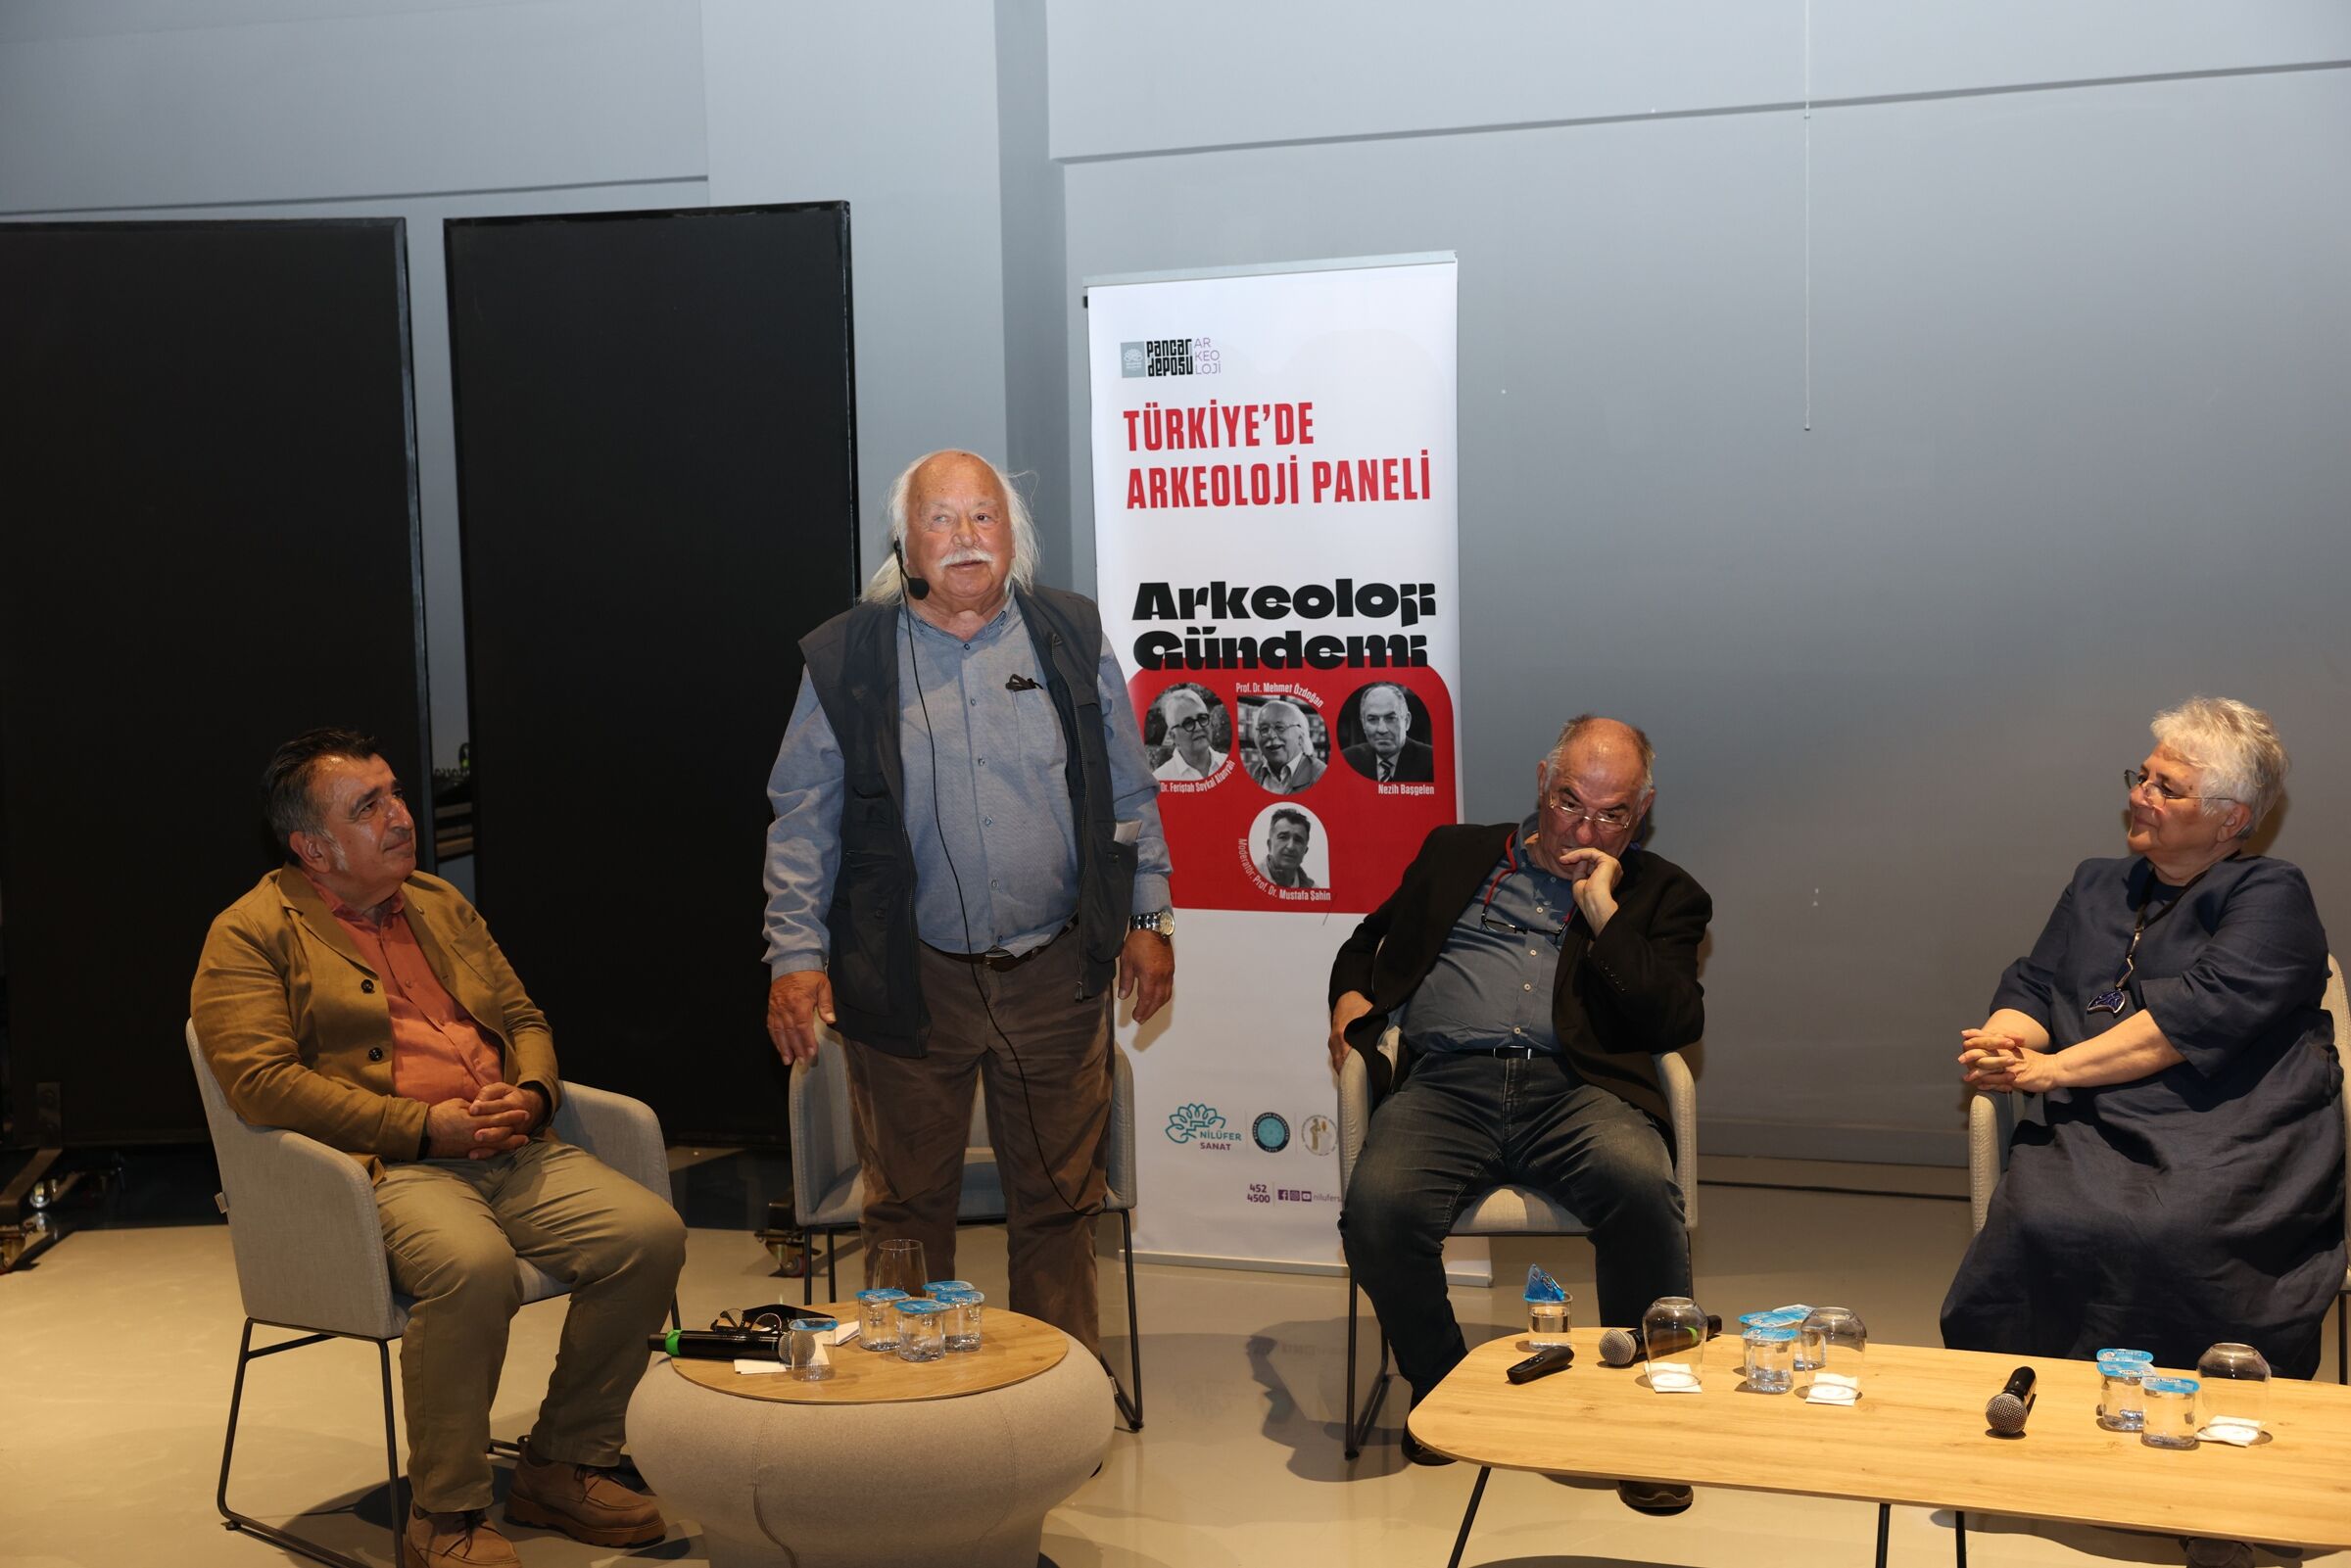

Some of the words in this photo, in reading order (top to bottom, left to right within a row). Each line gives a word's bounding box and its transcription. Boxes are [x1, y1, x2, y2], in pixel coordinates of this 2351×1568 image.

[1194, 337, 1211, 349] AR
[1195, 350, 1221, 361] KEO
[1147, 356, 1193, 377] deposu
[1195, 361, 1222, 375] LOJİ
[1123, 399, 1314, 451] TÜRKİYE'DE
[1127, 454, 1299, 509] ARKEOLOJİ
[1312, 449, 1430, 503] PANELİ
[1132, 578, 1436, 627] Arkeoloji
[1133, 626, 1428, 670] Gündemi
[1235, 682, 1252, 693] Prof.
[1253, 683, 1262, 693] Dr.
[1263, 683, 1293, 693] Mehmet
[1293, 683, 1324, 708] Özdoğan
[1160, 782, 1170, 792] Dr.
[1170, 782, 1195, 794] Feriştah
[1195, 777, 1217, 792] Soykal
[1378, 784, 1399, 794] Nezih
[1400, 784, 1435, 796] Başgelen
[1252, 874, 1268, 893] Prof.
[1268, 884, 1277, 898] Dr.
[1278, 889, 1309, 901] Mustafa
[1310, 889, 1331, 902] Şahin
[1200, 1129, 1242, 1142] NİLÜFER
[1200, 1142, 1231, 1151] SANAT
[1249, 1183, 1268, 1193] 452
[1247, 1193, 1271, 1204] 4500
[1313, 1193, 1341, 1203] nilufers
